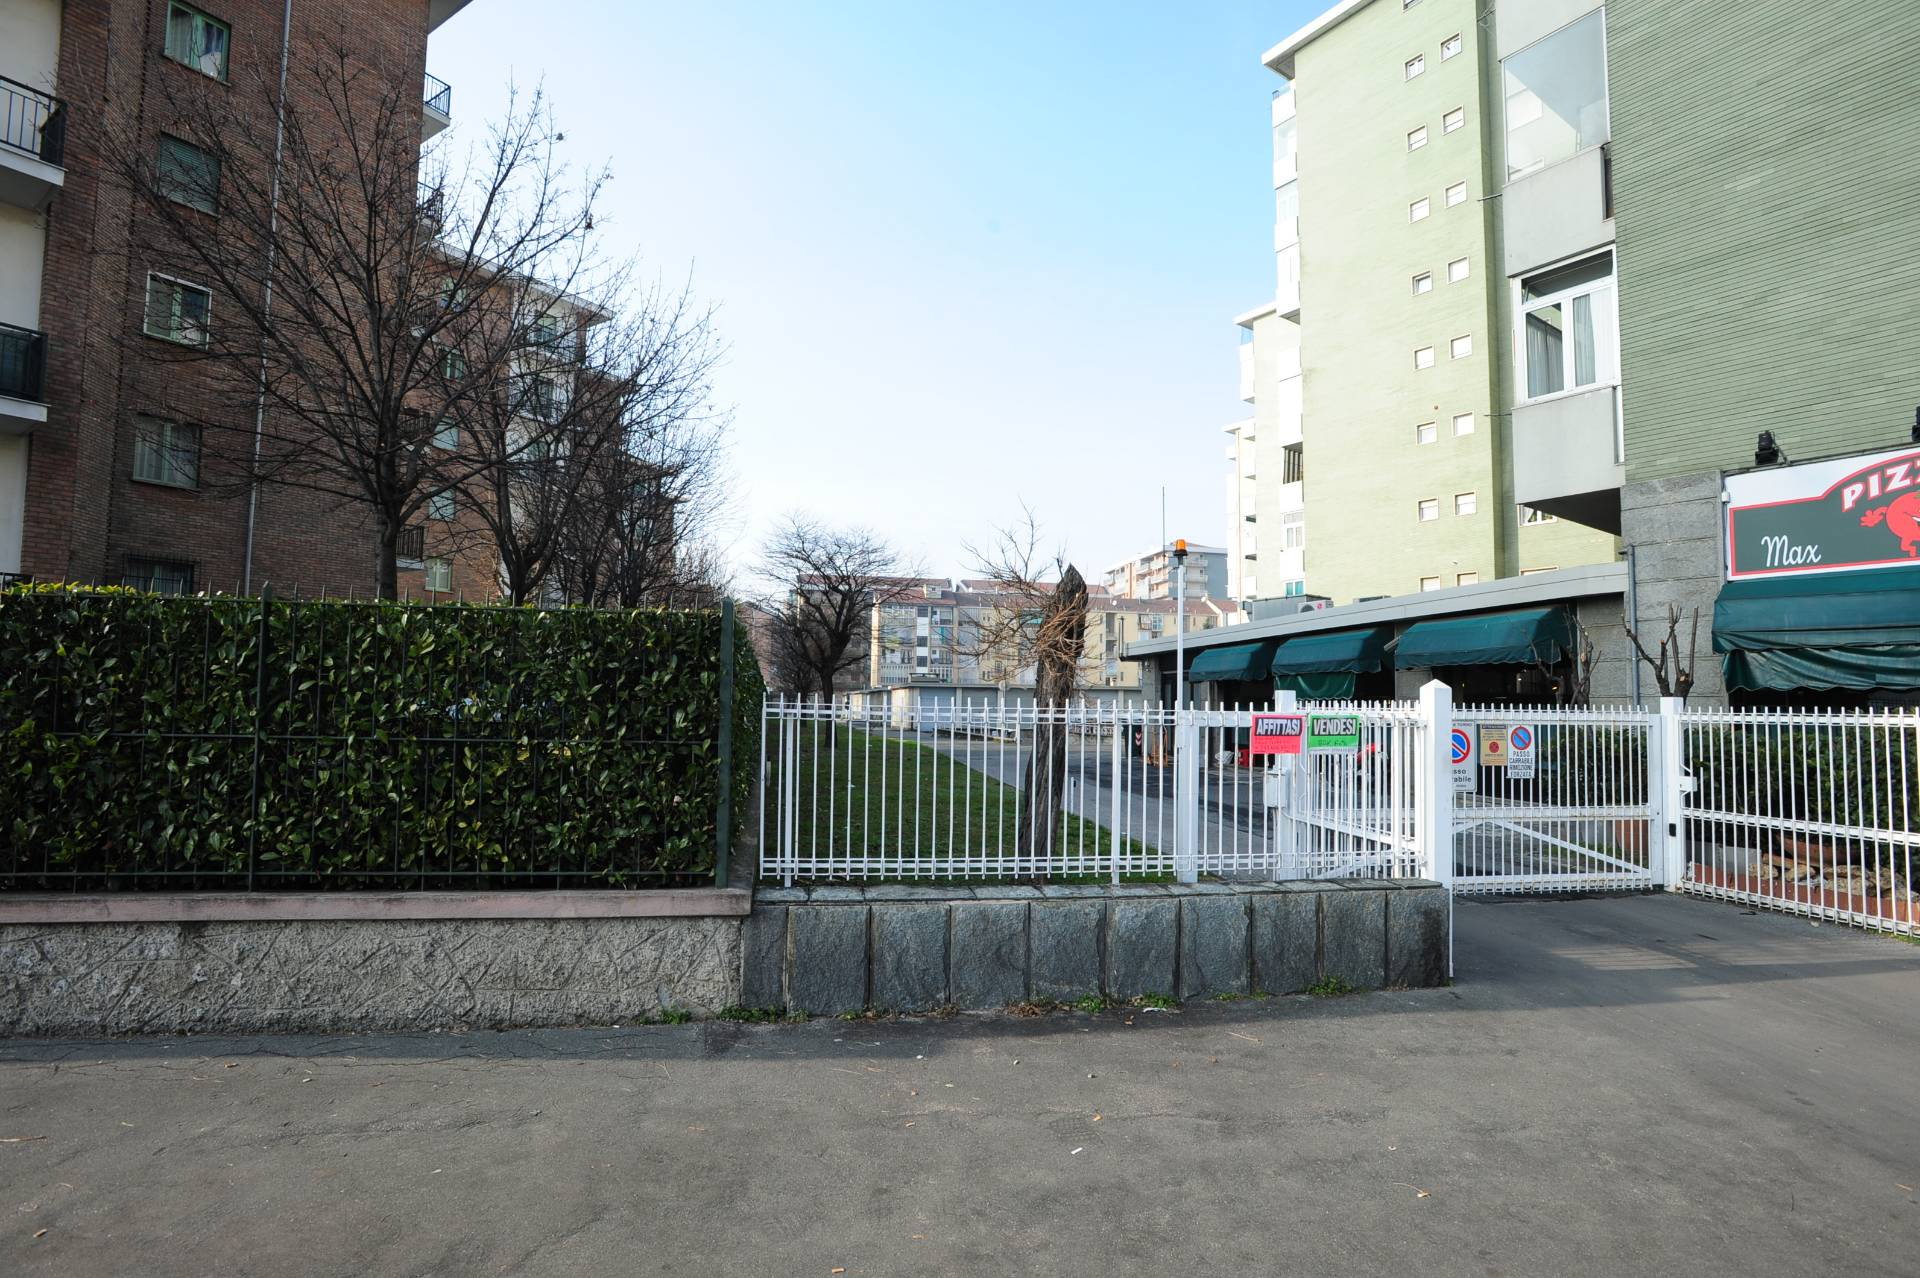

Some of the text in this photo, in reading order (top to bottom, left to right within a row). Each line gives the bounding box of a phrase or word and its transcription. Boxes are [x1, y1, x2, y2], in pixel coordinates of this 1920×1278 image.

[1842, 459, 1920, 512] PIZ
[1761, 534, 1822, 567] Max
[1256, 718, 1300, 735] AFFITTASI
[1313, 718, 1356, 735] VENDESI
